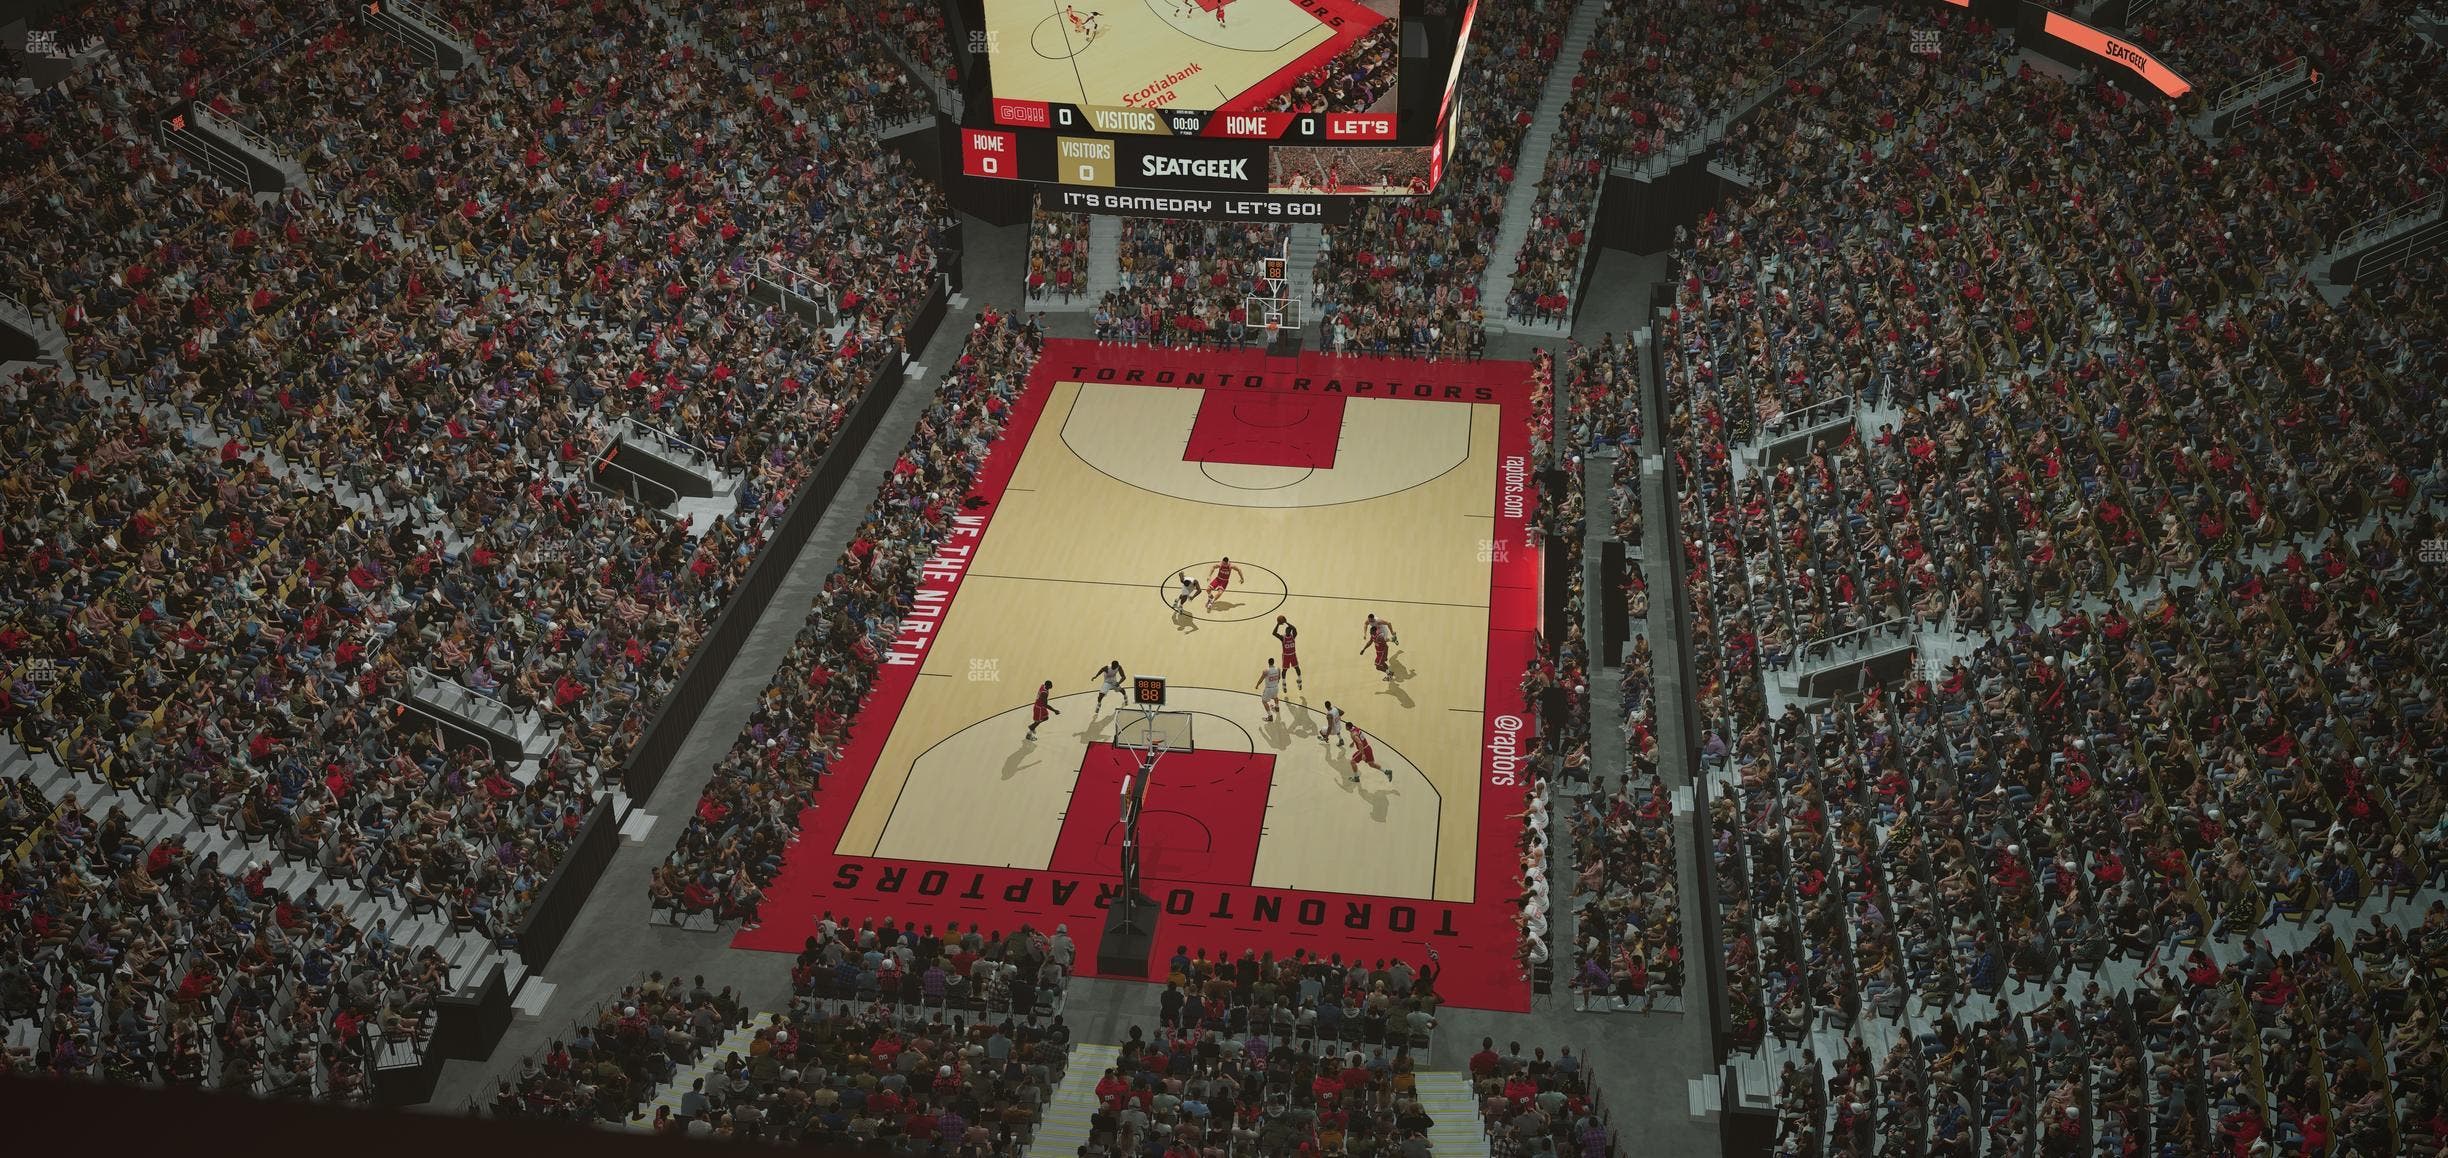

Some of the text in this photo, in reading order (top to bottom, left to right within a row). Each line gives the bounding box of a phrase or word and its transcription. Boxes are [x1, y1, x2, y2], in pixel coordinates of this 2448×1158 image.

[1300, 0, 1345, 27] ORS
[2106, 40, 2147, 73] SEATGEEK
[1122, 62, 1203, 108] Scotiabank
[1141, 90, 1177, 109] rena
[1001, 105, 1045, 123] GO!!!
[1059, 108, 1073, 126] 0
[1096, 110, 1156, 132] VISITORS
[1173, 117, 1199, 131] 00:00
[1226, 116, 1267, 136] HOME
[1301, 118, 1315, 136] 0
[1333, 120, 1389, 134] LET'S
[973, 134, 1005, 153] HOME
[1061, 141, 1111, 160] VISITORS
[982, 157, 998, 174] 0
[1079, 165, 1094, 181] 0
[1142, 154, 1249, 181] SEATGEEK
[1063, 192, 1322, 216] IT'S GAMEDAY LET'S GO!
[1071, 366, 1494, 401] TORONTO RAPTORS
[1504, 456, 1525, 519] raptors.com
[886, 515, 986, 666] WE THE NORTH
[1141, 689, 1159, 701] 88
[1487, 715, 1523, 787] @raptors
[832, 863, 1459, 936] TORONTO RAPTORS
